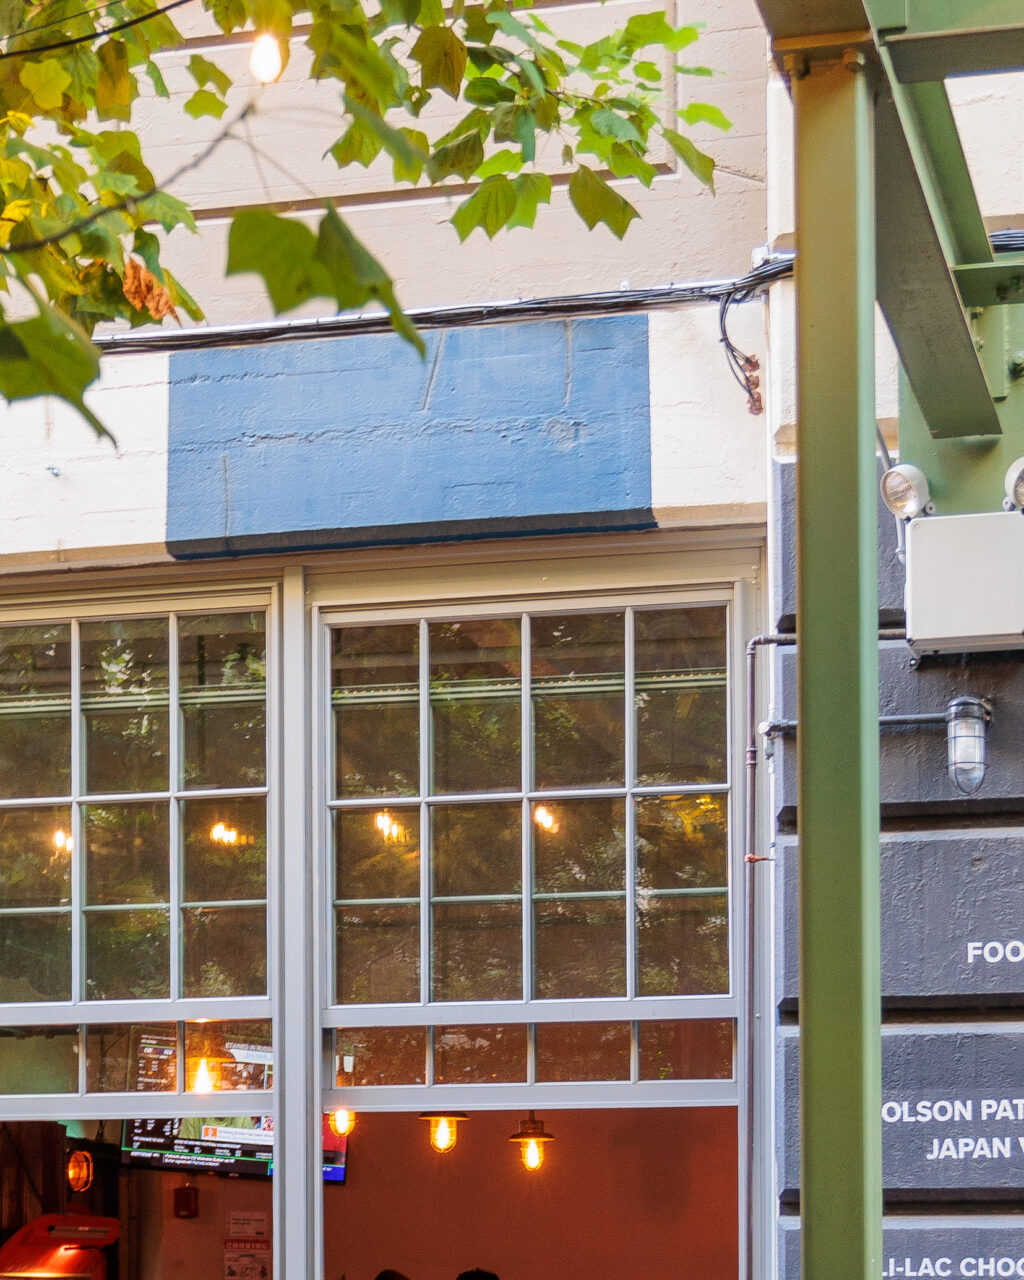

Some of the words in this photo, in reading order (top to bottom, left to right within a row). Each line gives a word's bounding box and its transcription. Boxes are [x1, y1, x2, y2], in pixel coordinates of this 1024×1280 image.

[881, 1099, 973, 1123] OLSON
[925, 1136, 1011, 1160] JAPAN
[881, 1256, 953, 1277] I-LAC
